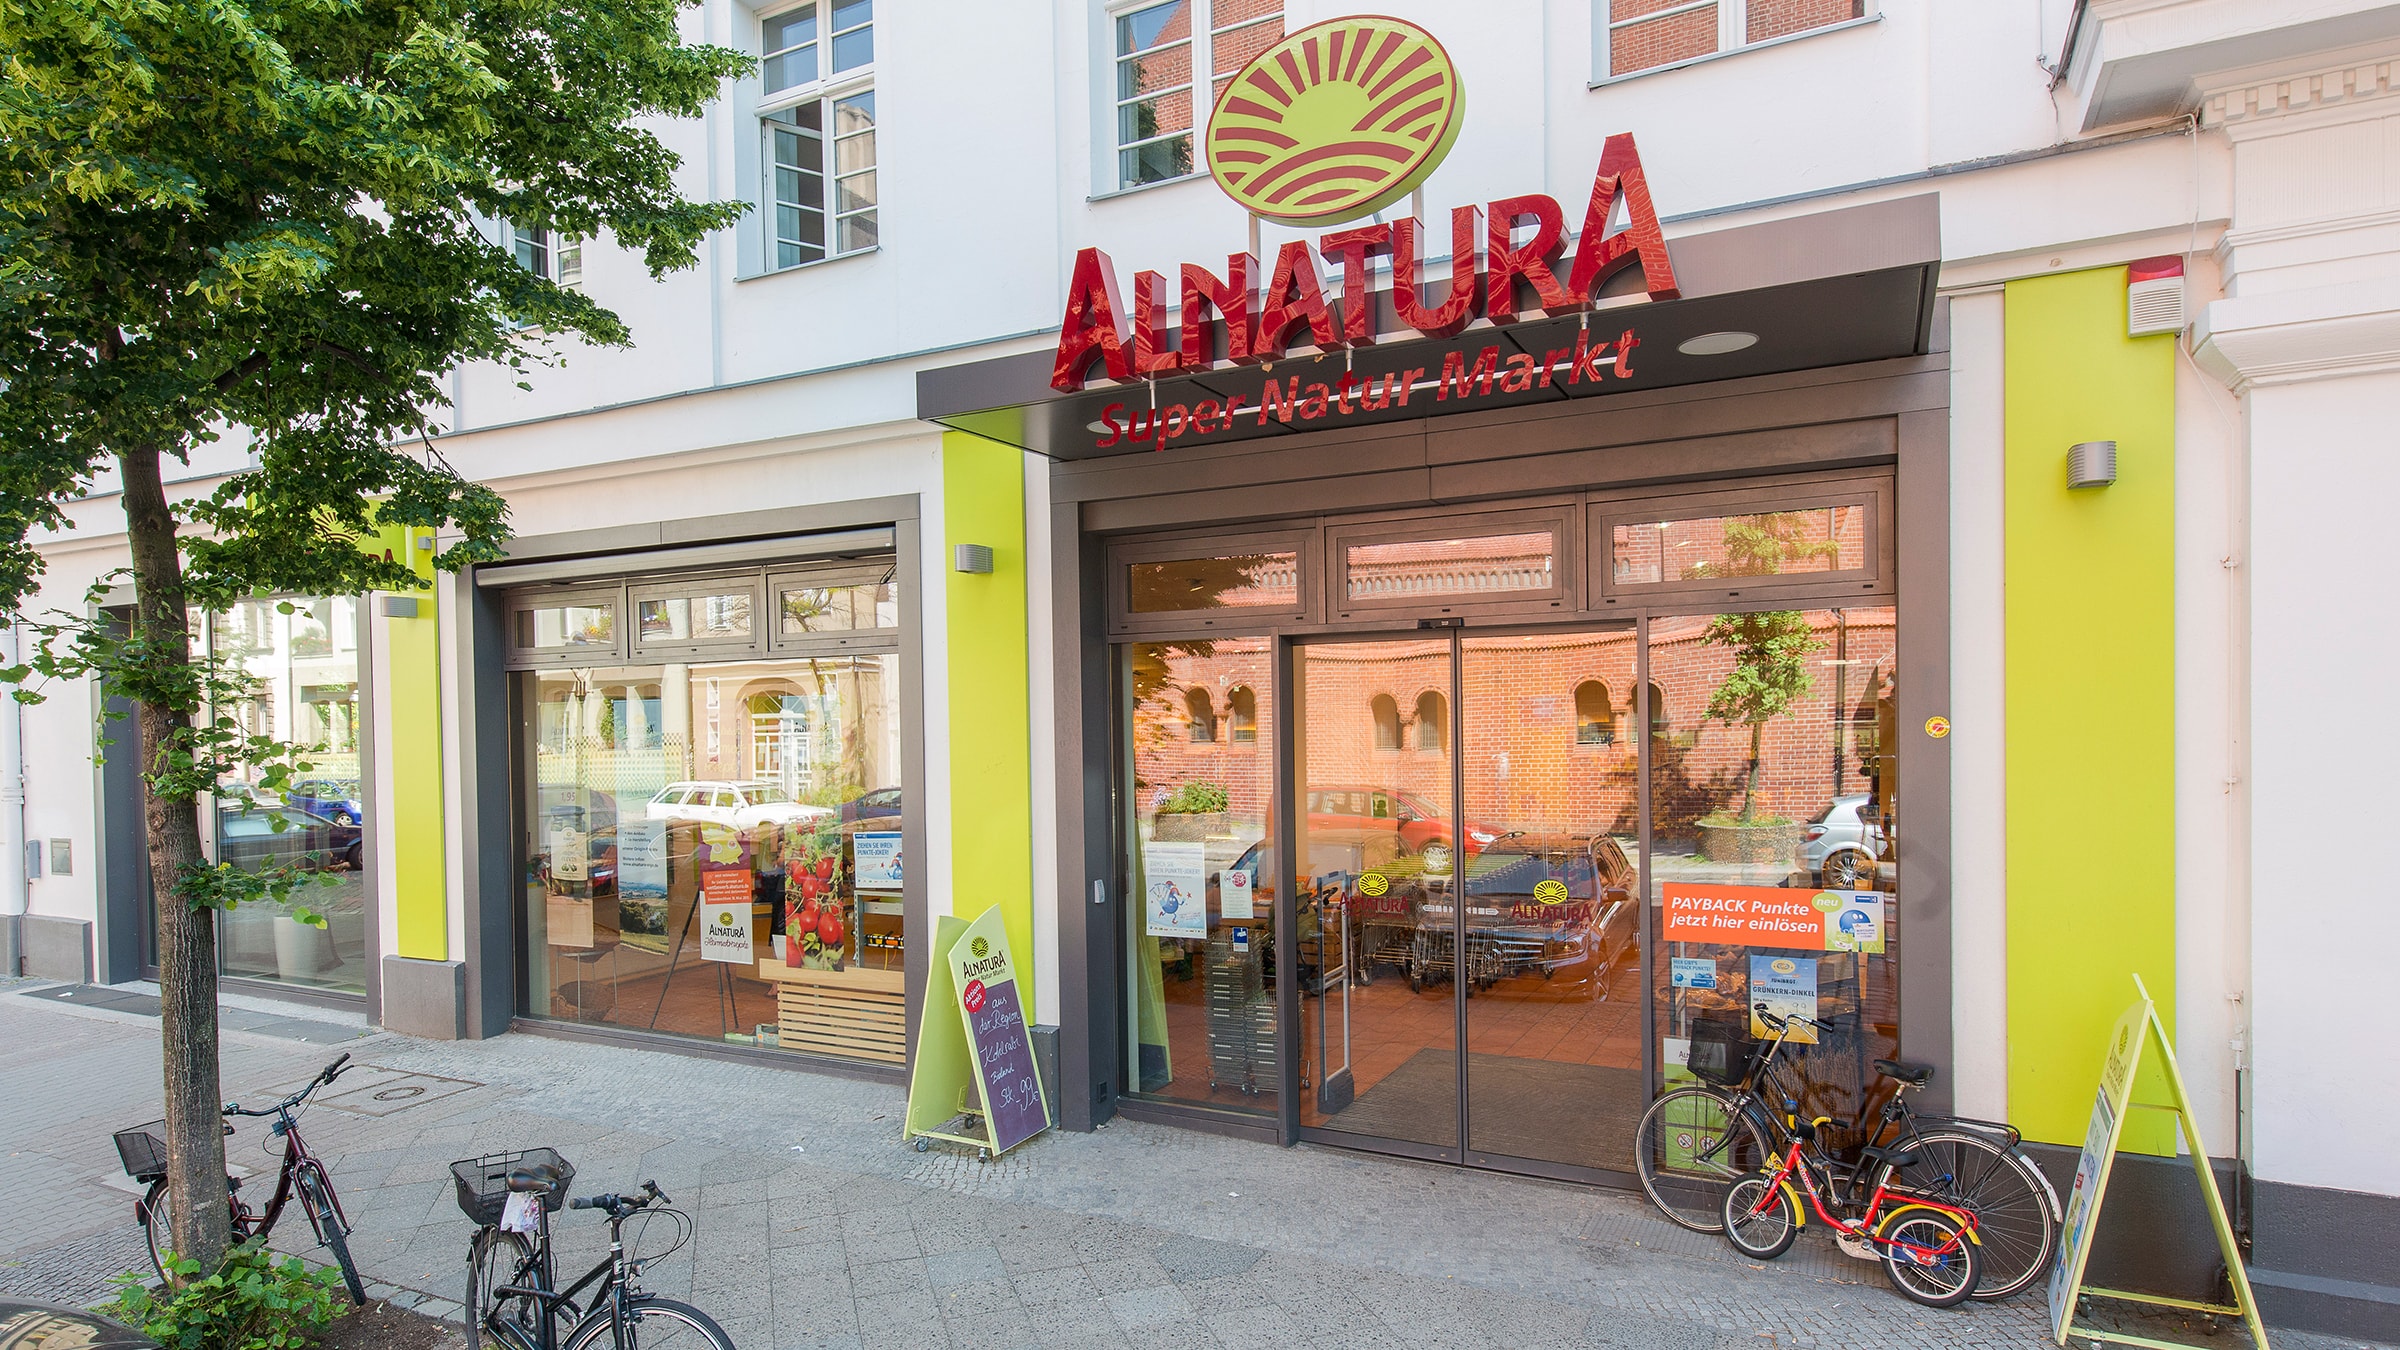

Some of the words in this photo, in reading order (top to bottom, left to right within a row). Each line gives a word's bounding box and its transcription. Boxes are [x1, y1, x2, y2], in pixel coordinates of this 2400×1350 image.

[1050, 132, 1681, 394] ALNATURA
[1096, 393, 1246, 452] Super
[1257, 367, 1425, 426] Natur
[1437, 328, 1640, 401] Markt
[1337, 892, 1410, 913] ALNATURA
[1511, 900, 1592, 922] ALNATURA
[1670, 896, 1747, 913] PAYBACK
[1751, 900, 1810, 917] Punkte
[1815, 898, 1839, 907] neu
[709, 923, 745, 938] ALNATURA
[1669, 913, 1708, 928] jetzt
[1712, 914, 1745, 930] hier
[1749, 917, 1819, 934] einlösen
[963, 950, 1006, 979] ALNATURA
[965, 982, 982, 1005] Aktions
[971, 992, 983, 1008] Preis
[1752, 986, 1815, 997] GRÜNKERN-DINKEL
[991, 996, 1007, 1009] aus
[991, 1007, 1021, 1029] Region
